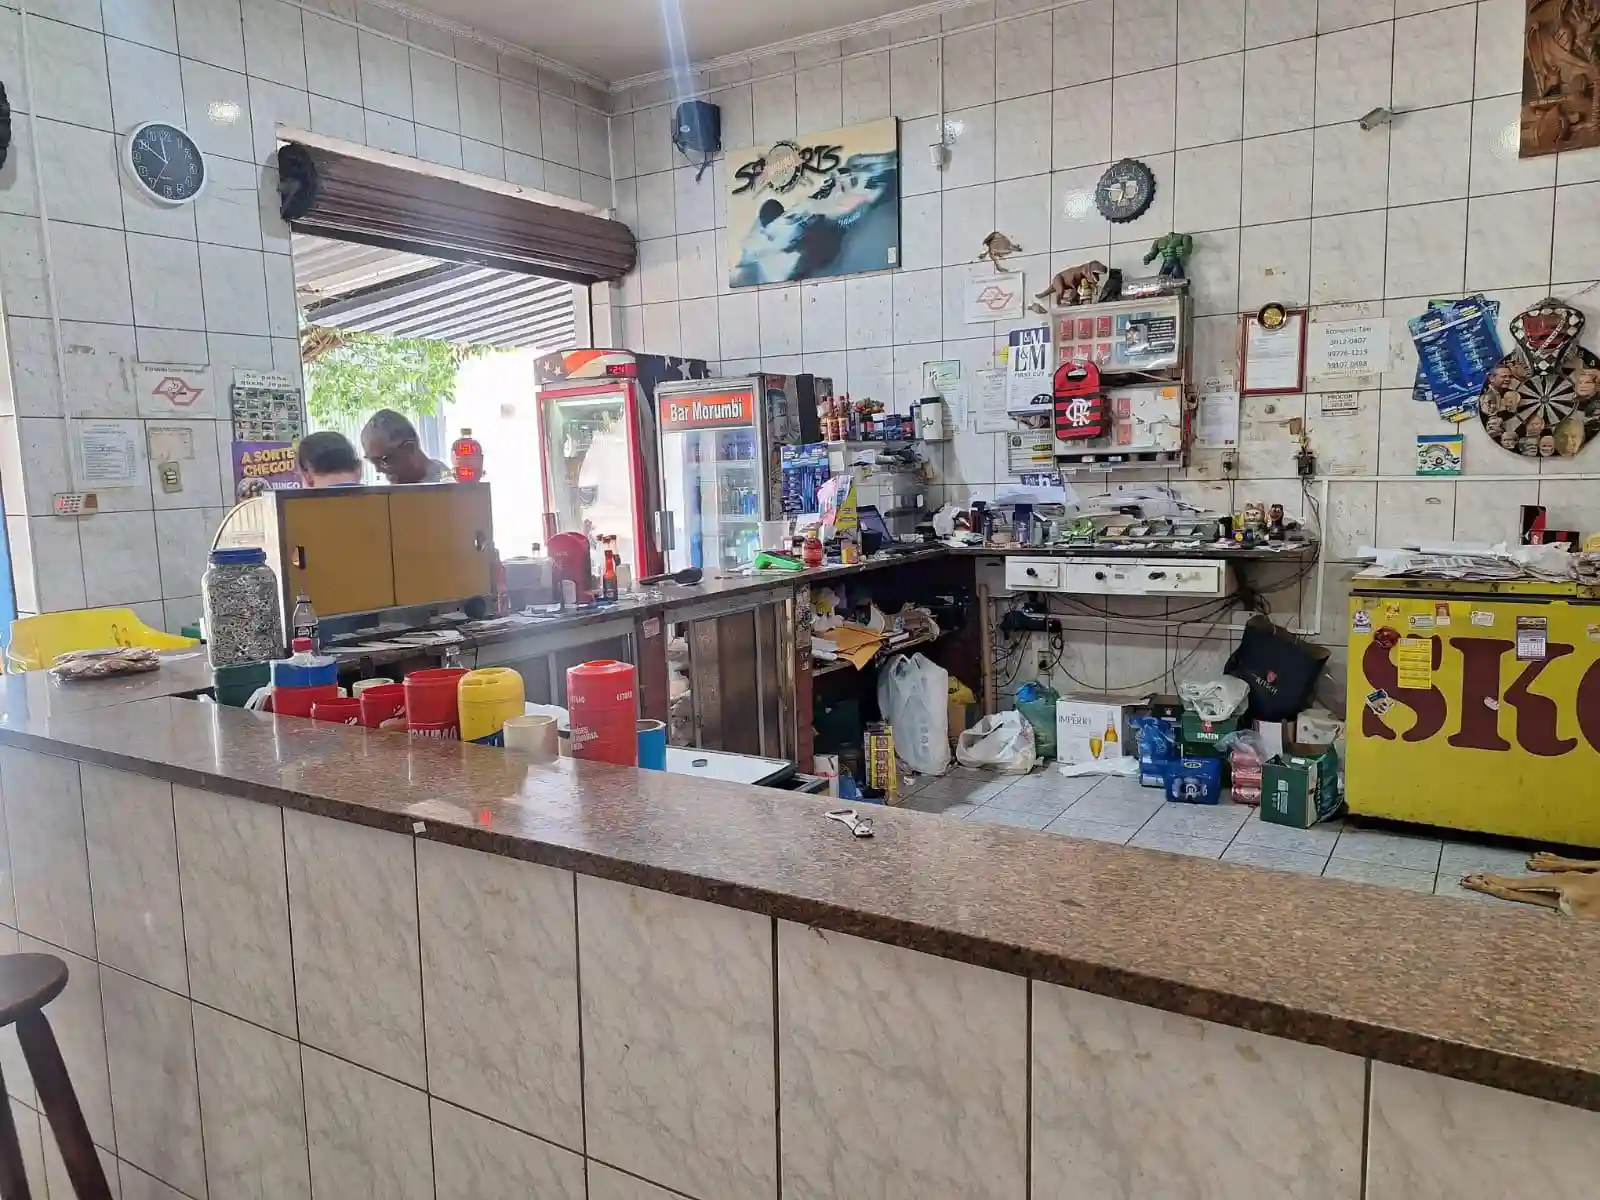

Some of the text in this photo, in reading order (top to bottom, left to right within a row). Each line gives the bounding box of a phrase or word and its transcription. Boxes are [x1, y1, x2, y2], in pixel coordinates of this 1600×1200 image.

[1015, 344, 1046, 372] L&M
[670, 398, 743, 422] Bar Morumbi
[242, 452, 253, 465] A
[243, 459, 295, 476] CHEGOU
[1362, 633, 1600, 757] SK
[1197, 732, 1219, 740] SPATEN
